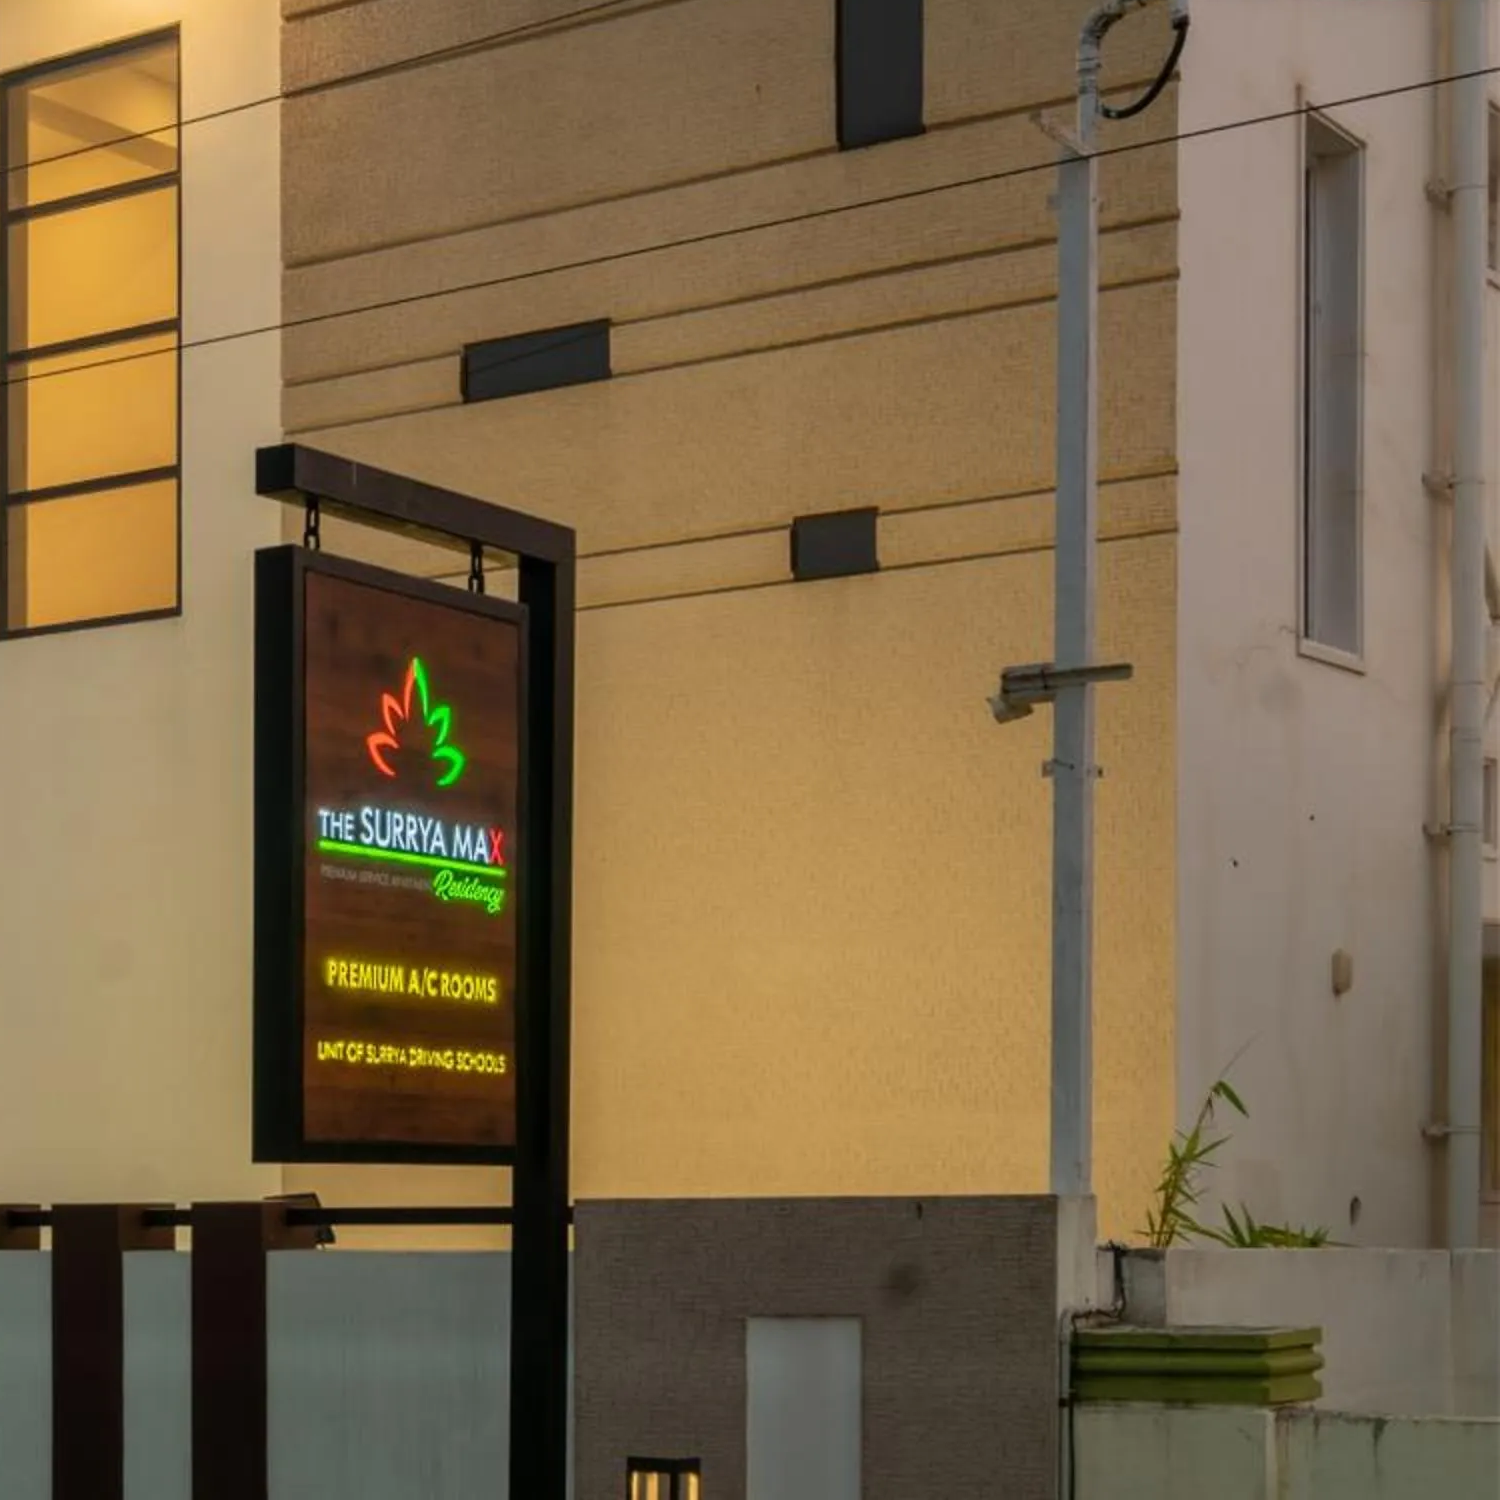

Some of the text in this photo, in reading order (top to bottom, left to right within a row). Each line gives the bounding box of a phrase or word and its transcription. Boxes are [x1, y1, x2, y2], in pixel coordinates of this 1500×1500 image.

[318, 805, 504, 866] THE SURRYA MAX
[433, 869, 505, 914] Residency
[327, 959, 498, 1003] PREMIUM A/C ROOMS
[317, 1040, 345, 1061] UNIT
[346, 1041, 364, 1063] OF
[408, 1047, 455, 1070] DRIVING
[456, 1051, 507, 1074] SCHOOLS
